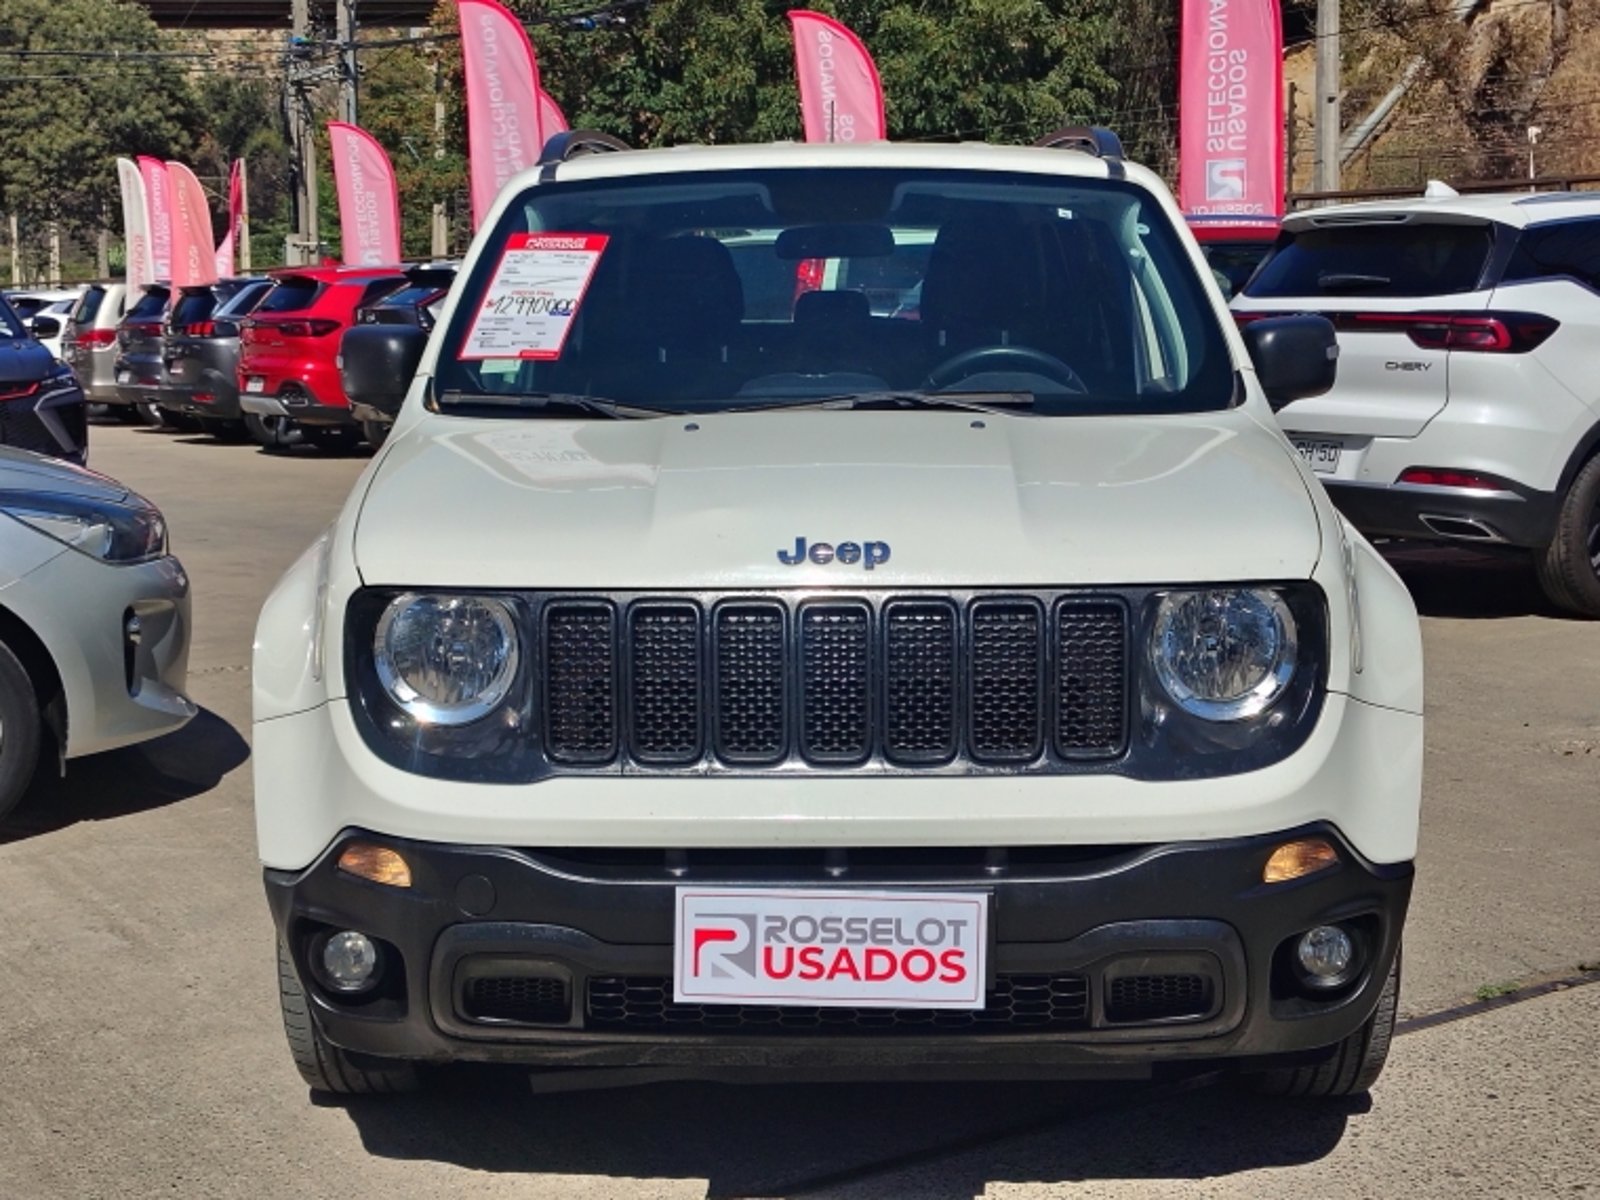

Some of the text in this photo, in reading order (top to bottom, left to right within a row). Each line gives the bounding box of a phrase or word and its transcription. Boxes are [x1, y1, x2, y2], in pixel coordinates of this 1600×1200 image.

[1385, 361, 1433, 371] CHERY
[777, 536, 891, 570] Jeep
[763, 915, 968, 946] ROSSELOT
[763, 946, 967, 984] USADOS
